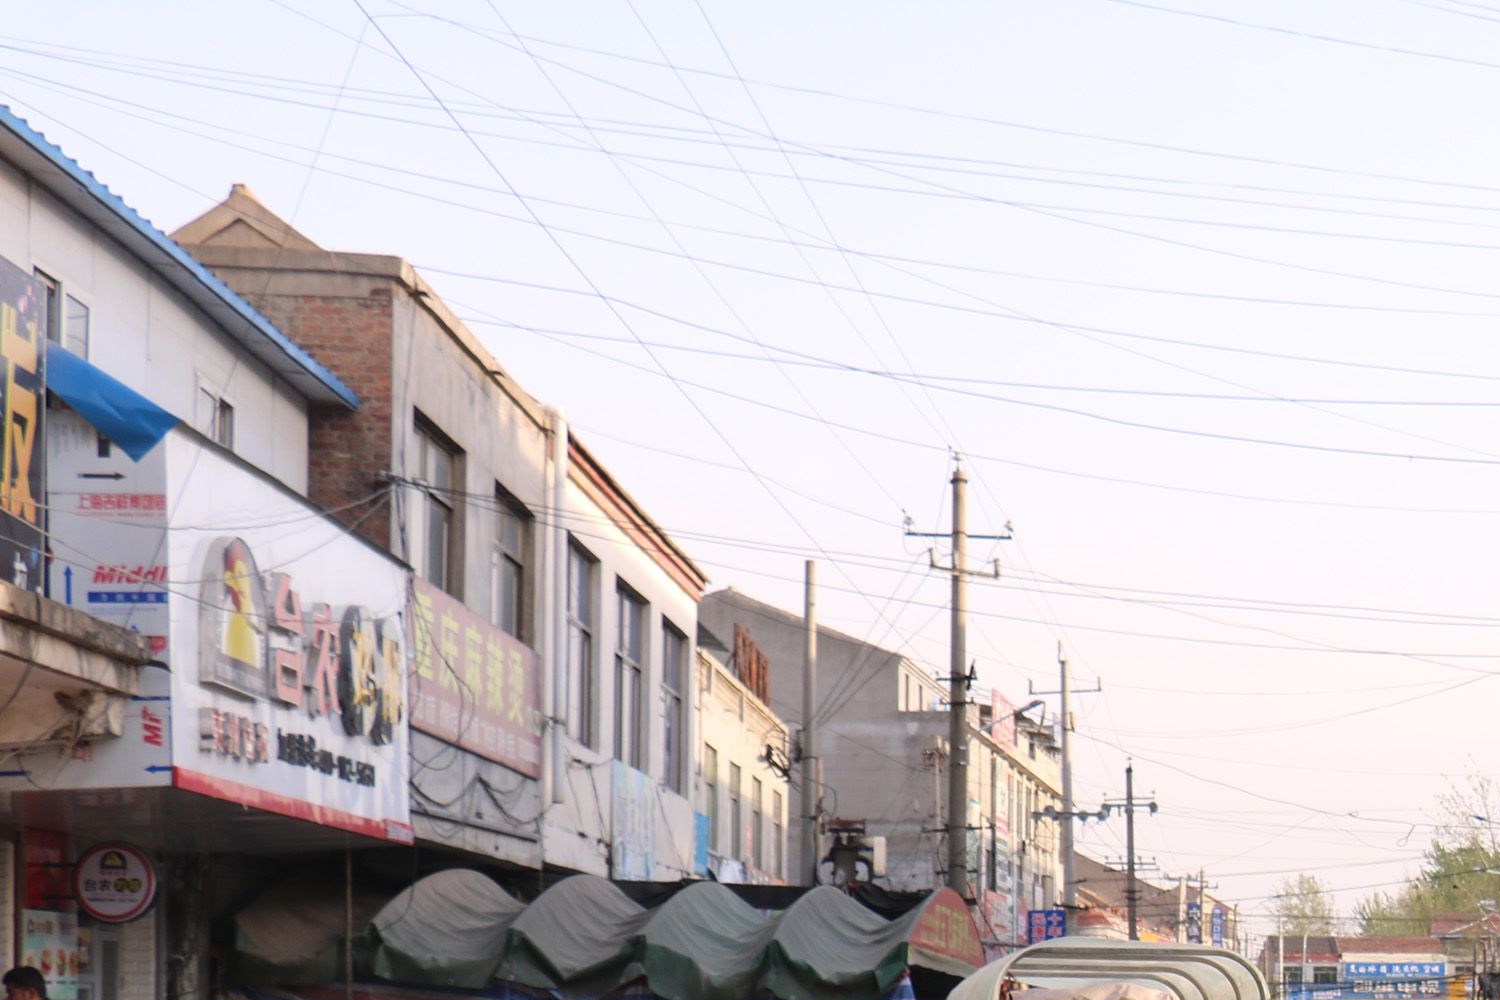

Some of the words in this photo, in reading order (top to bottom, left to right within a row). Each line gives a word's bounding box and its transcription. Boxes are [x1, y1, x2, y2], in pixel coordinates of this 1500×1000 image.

[413, 590, 524, 727] 重庆麻辣烫
